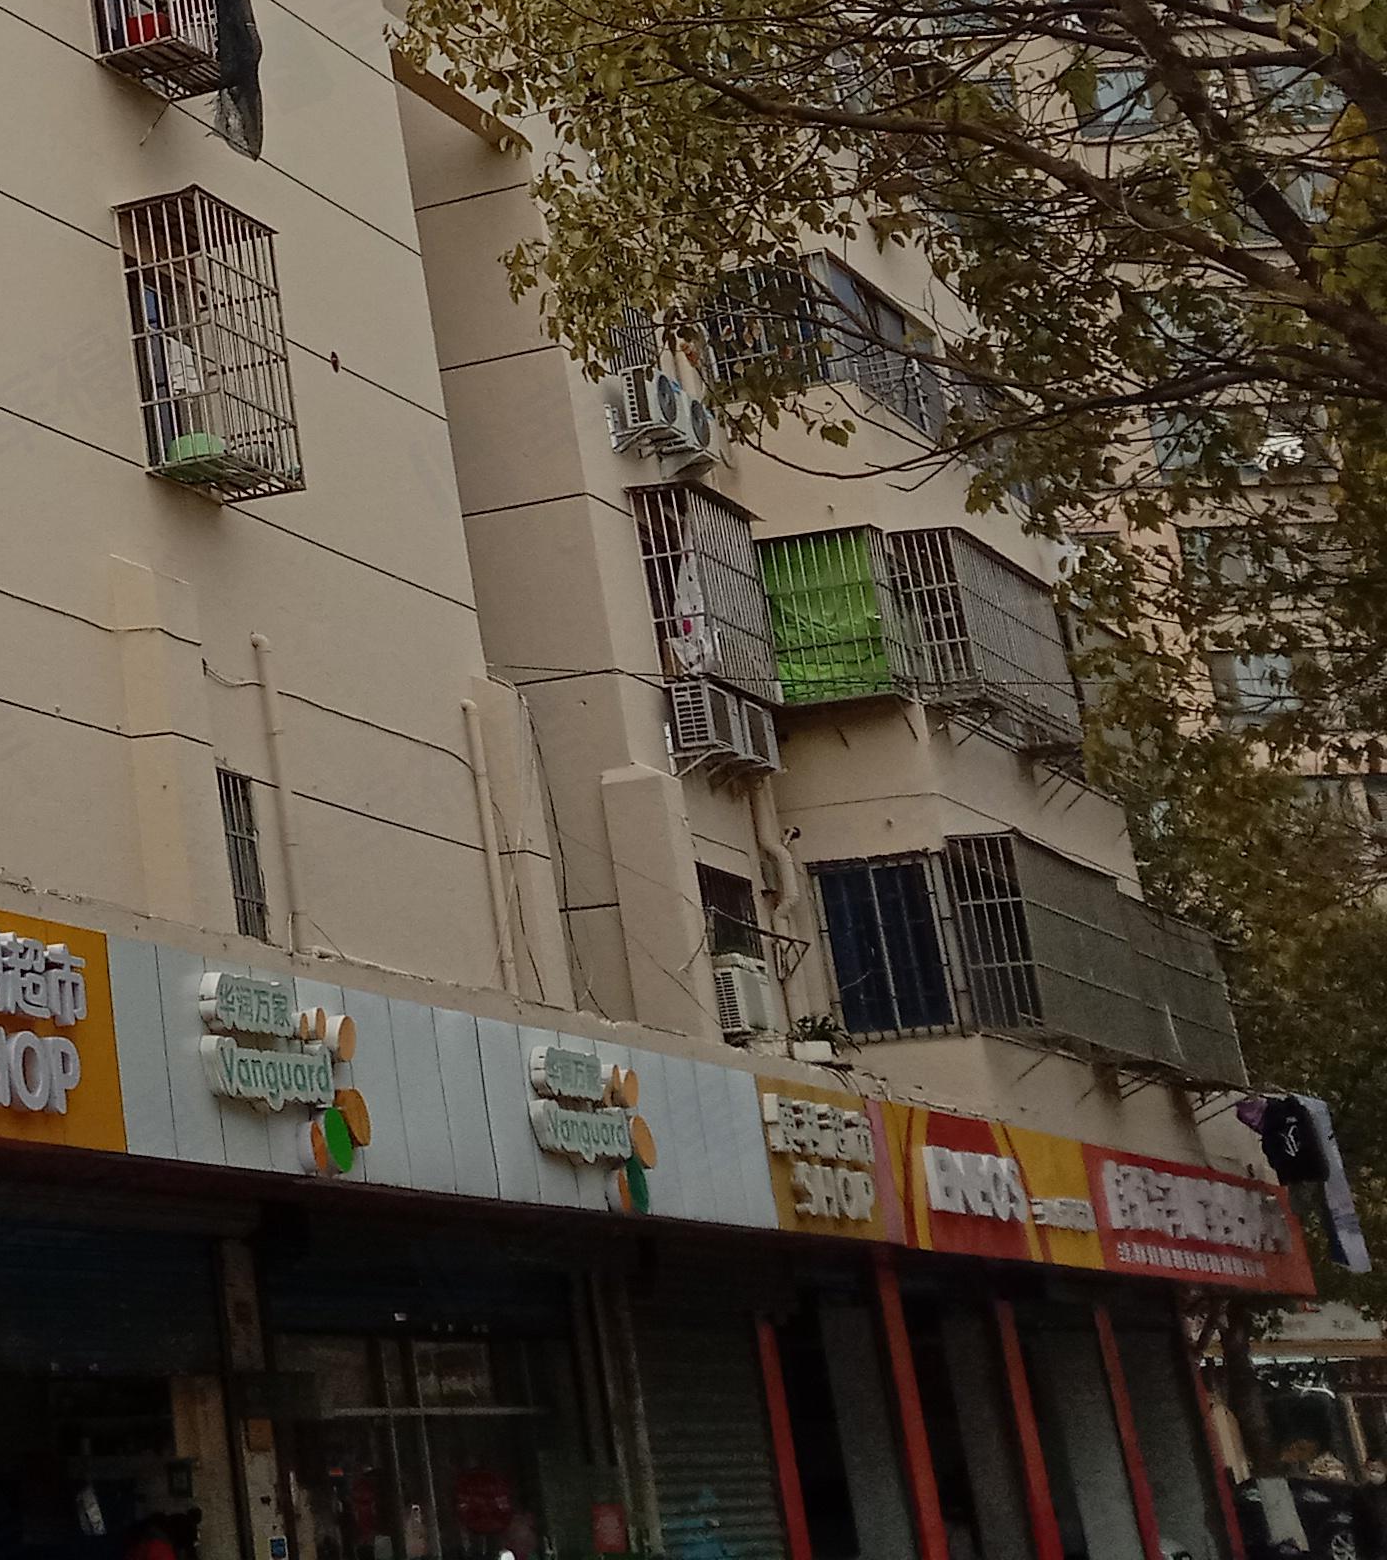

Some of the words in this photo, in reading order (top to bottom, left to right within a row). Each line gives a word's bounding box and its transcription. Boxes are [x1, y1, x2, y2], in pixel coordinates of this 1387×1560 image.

[216, 980, 293, 1030] 华润万家
[217, 1043, 331, 1100] Vanguard
[545, 1107, 629, 1155] Vanguard
[791, 1161, 877, 1223] SHOP
